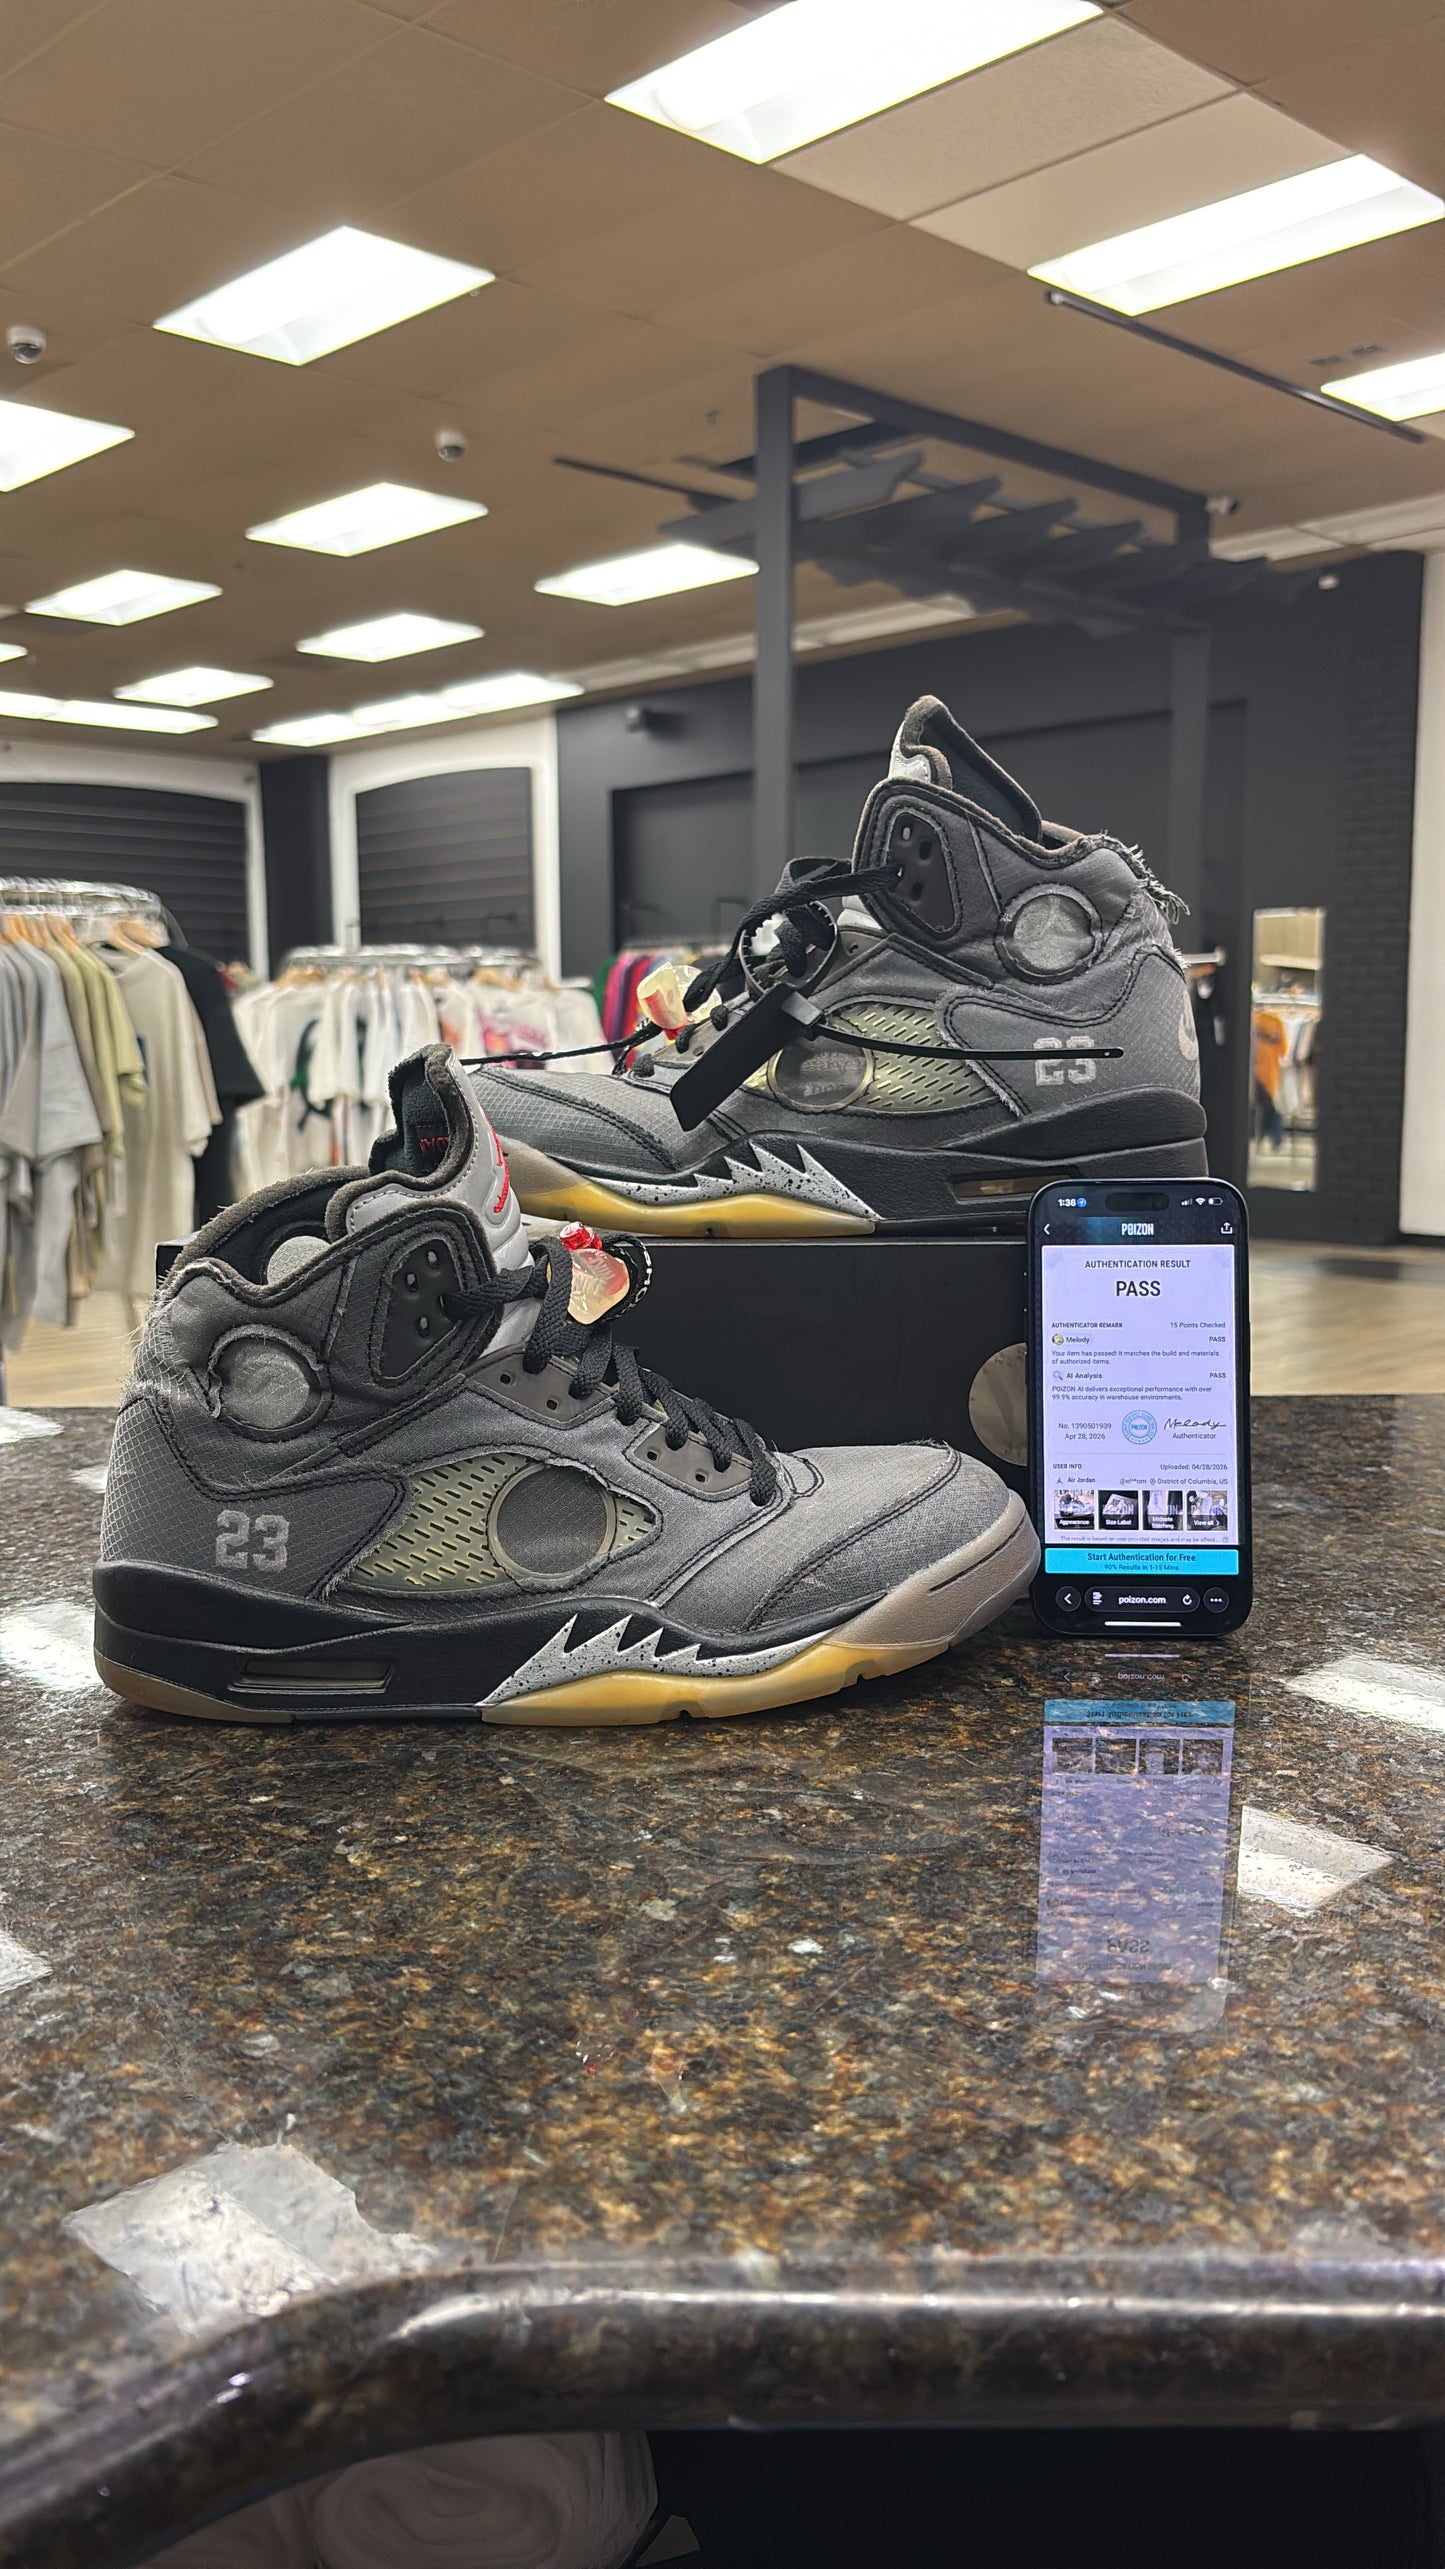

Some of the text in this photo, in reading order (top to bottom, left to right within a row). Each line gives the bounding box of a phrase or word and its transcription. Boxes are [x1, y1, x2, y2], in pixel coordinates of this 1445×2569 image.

[1122, 1223, 1154, 1235] POIZON
[1085, 1260, 1190, 1268] AUTHENTICATION RESULT
[1116, 1280, 1161, 1296] PASS
[215, 1509, 290, 1573] 23
[1087, 1553, 1106, 1561] Start
[1108, 1553, 1164, 1561] Authentication
[1119, 1596, 1166, 1605] poizon.com
